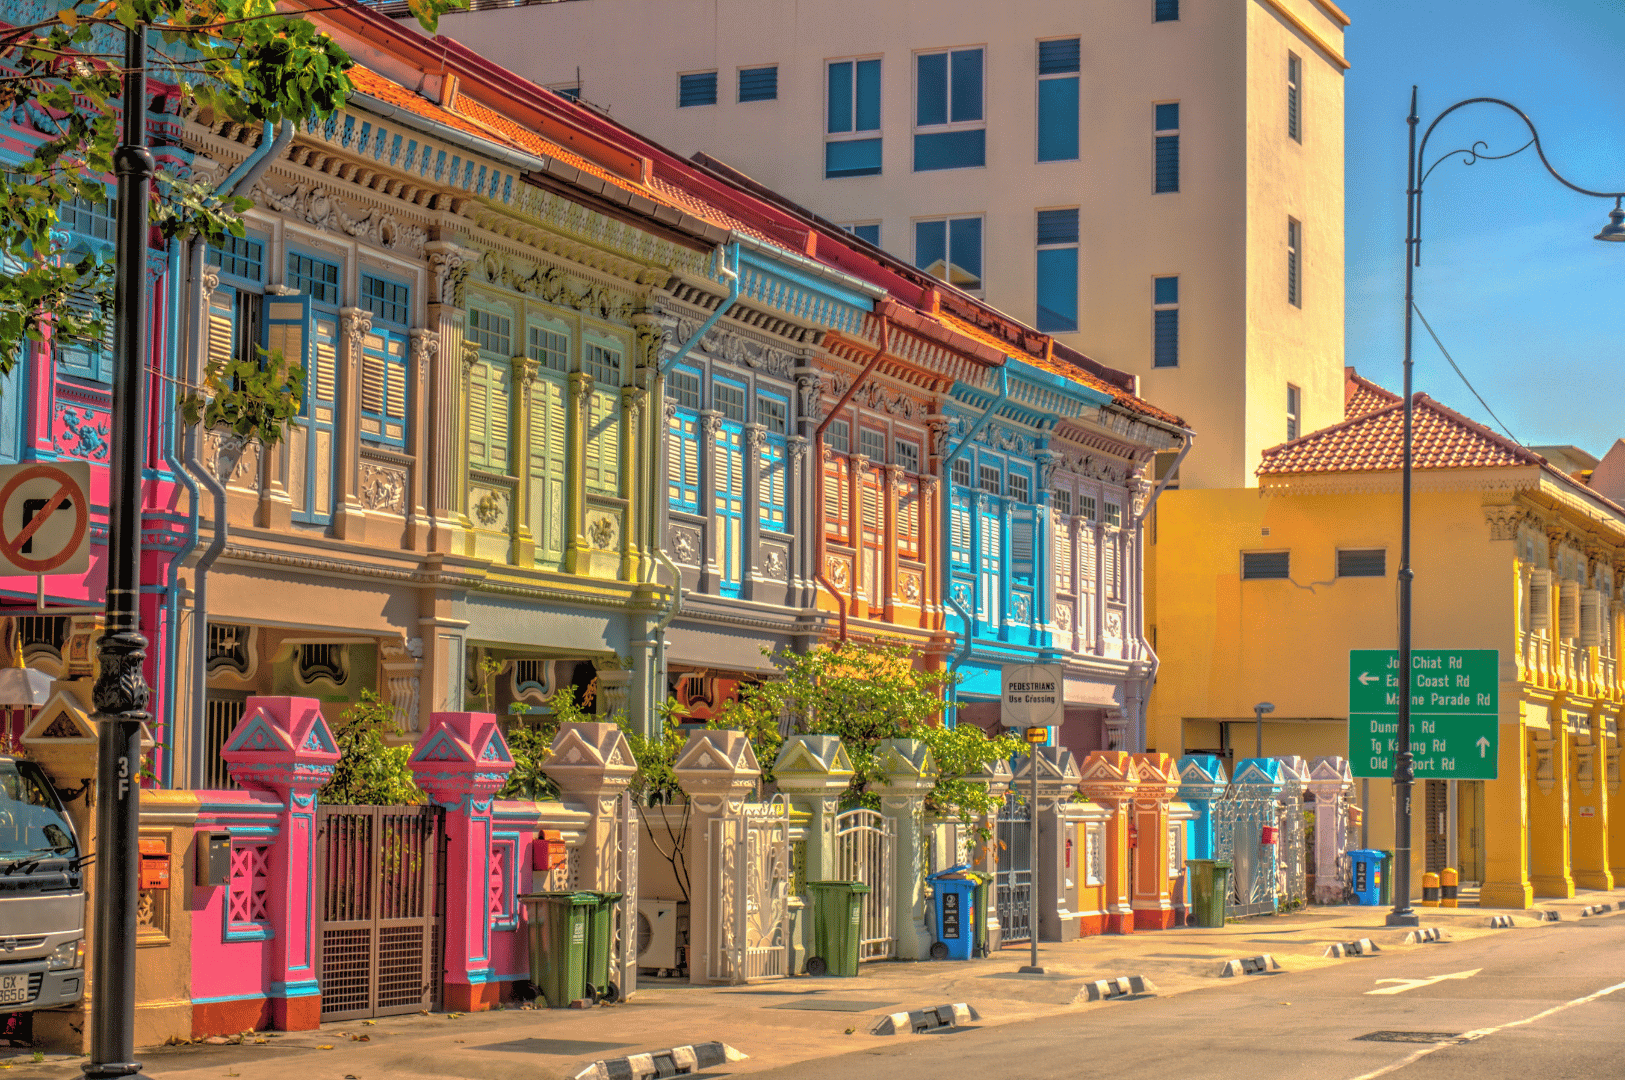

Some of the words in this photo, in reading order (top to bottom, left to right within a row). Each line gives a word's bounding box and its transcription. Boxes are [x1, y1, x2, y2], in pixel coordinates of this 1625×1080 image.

[1412, 656, 1442, 669] Chiat
[1449, 656, 1463, 669] Rd
[1009, 682, 1055, 691] PEDESTRIANS
[1417, 674, 1450, 687] Coast
[1456, 674, 1470, 687] Rd
[1009, 695, 1022, 703] Use
[1025, 694, 1055, 705] Crossing
[1431, 692, 1470, 706] Parade
[1477, 693, 1491, 706] Rd
[1370, 720, 1415, 733] Dunmn
[1421, 720, 1435, 733] Rd
[1371, 738, 1382, 754] Tg
[1433, 739, 1446, 752] Rd
[1370, 757, 1388, 770] Old
[1441, 757, 1455, 770] Rd
[118, 756, 129, 800] 3F
[3, 976, 17, 989] GX
